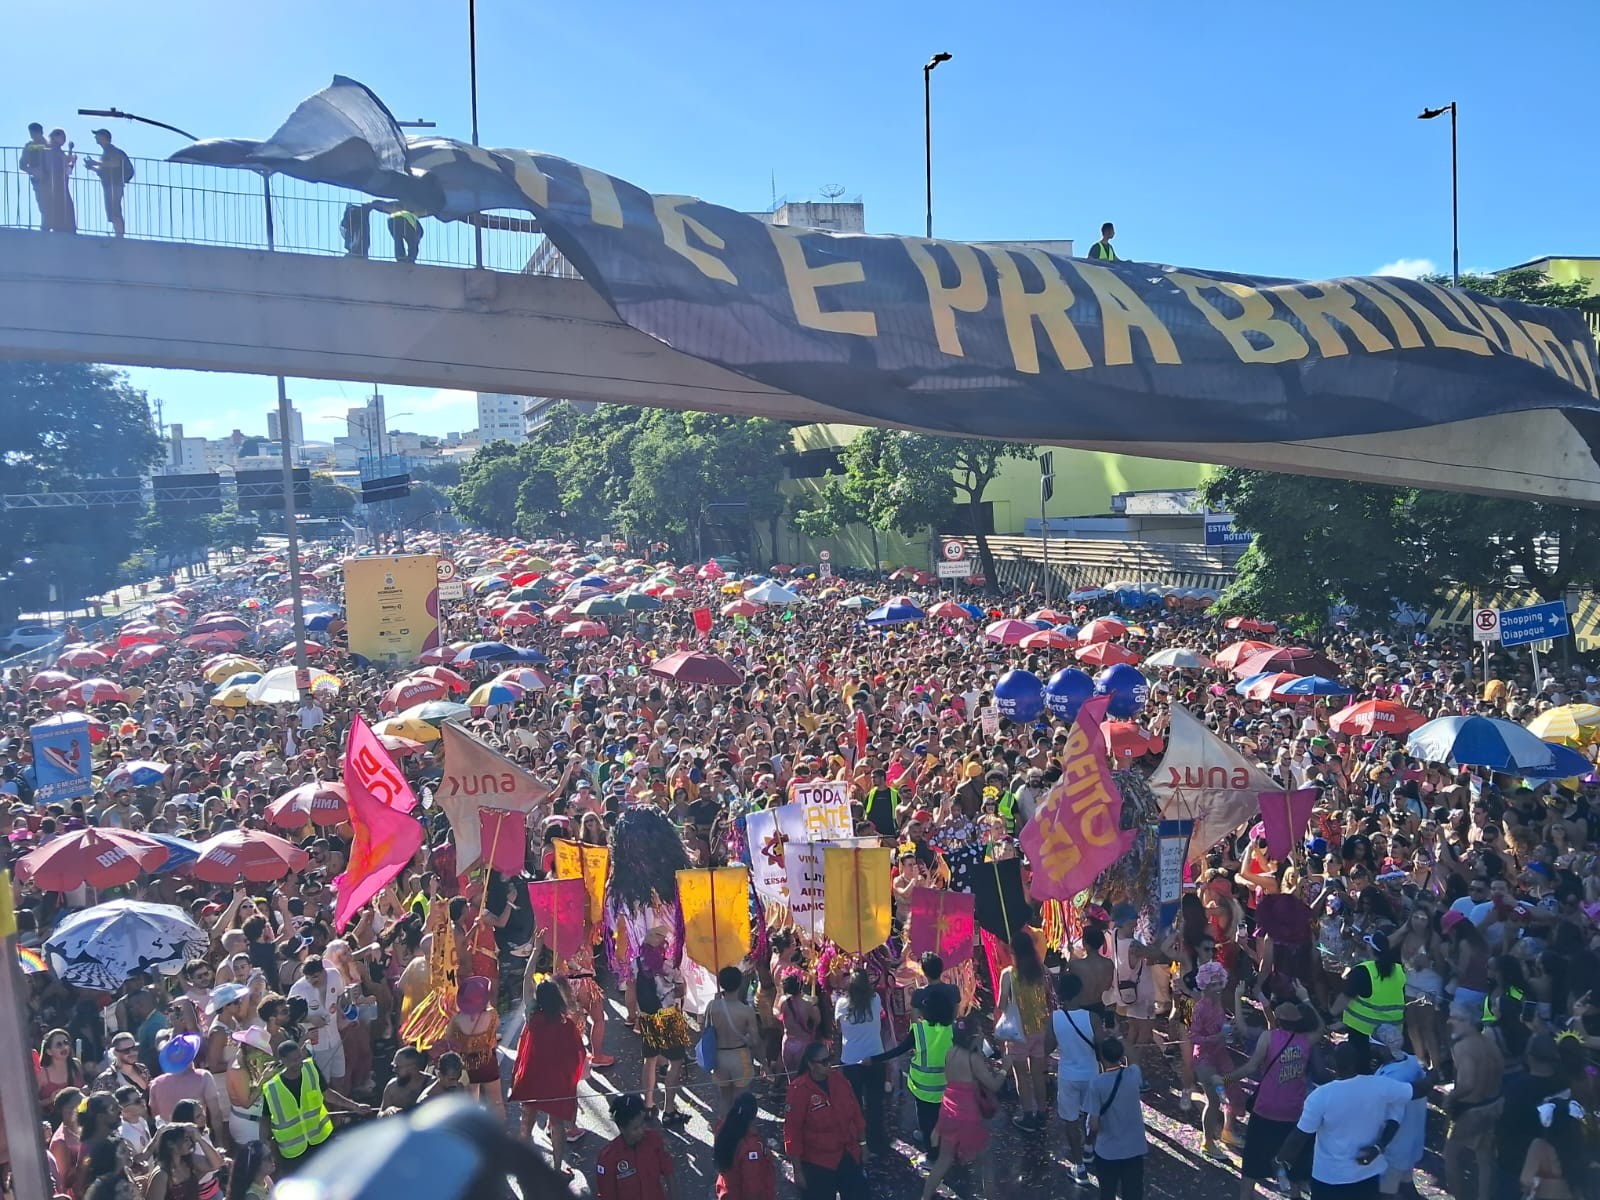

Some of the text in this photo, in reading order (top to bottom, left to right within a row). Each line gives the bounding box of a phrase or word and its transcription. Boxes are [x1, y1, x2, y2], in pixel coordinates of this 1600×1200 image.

[904, 236, 1182, 375] PRA
[948, 546, 961, 555] 60
[437, 565, 451, 575] 60
[1501, 612, 1543, 627] Shopping
[1503, 625, 1545, 639] Oiapoque
[462, 773, 515, 795] una
[1185, 766, 1249, 789] una
[799, 788, 843, 805] TODA
[804, 805, 849, 829] ENTE
[804, 872, 825, 883] LUT
